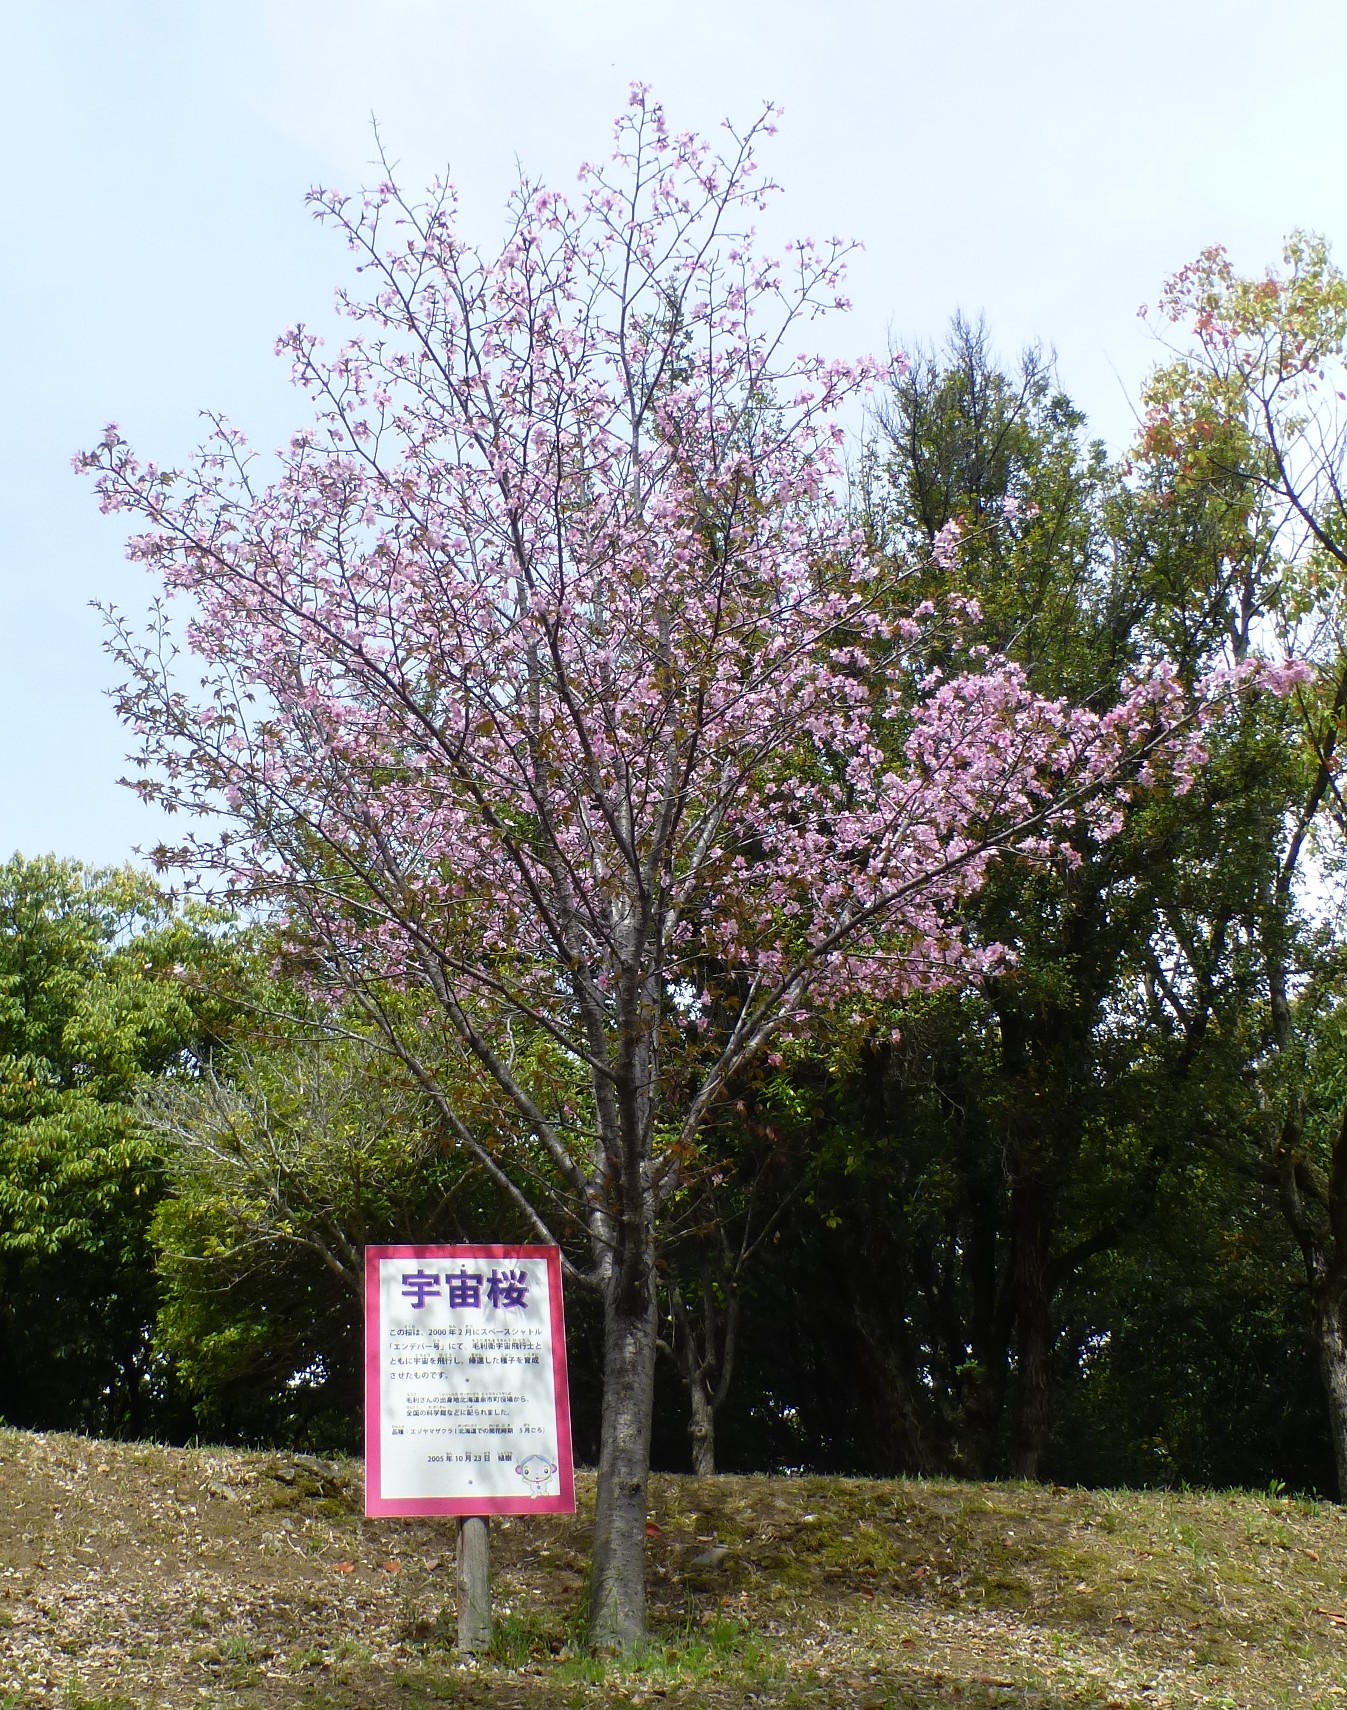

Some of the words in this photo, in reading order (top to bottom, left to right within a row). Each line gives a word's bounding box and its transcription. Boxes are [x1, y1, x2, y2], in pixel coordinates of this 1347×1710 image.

[401, 1268, 529, 1310] 宇宙桜
[390, 1371, 449, 1380] させたものです。
